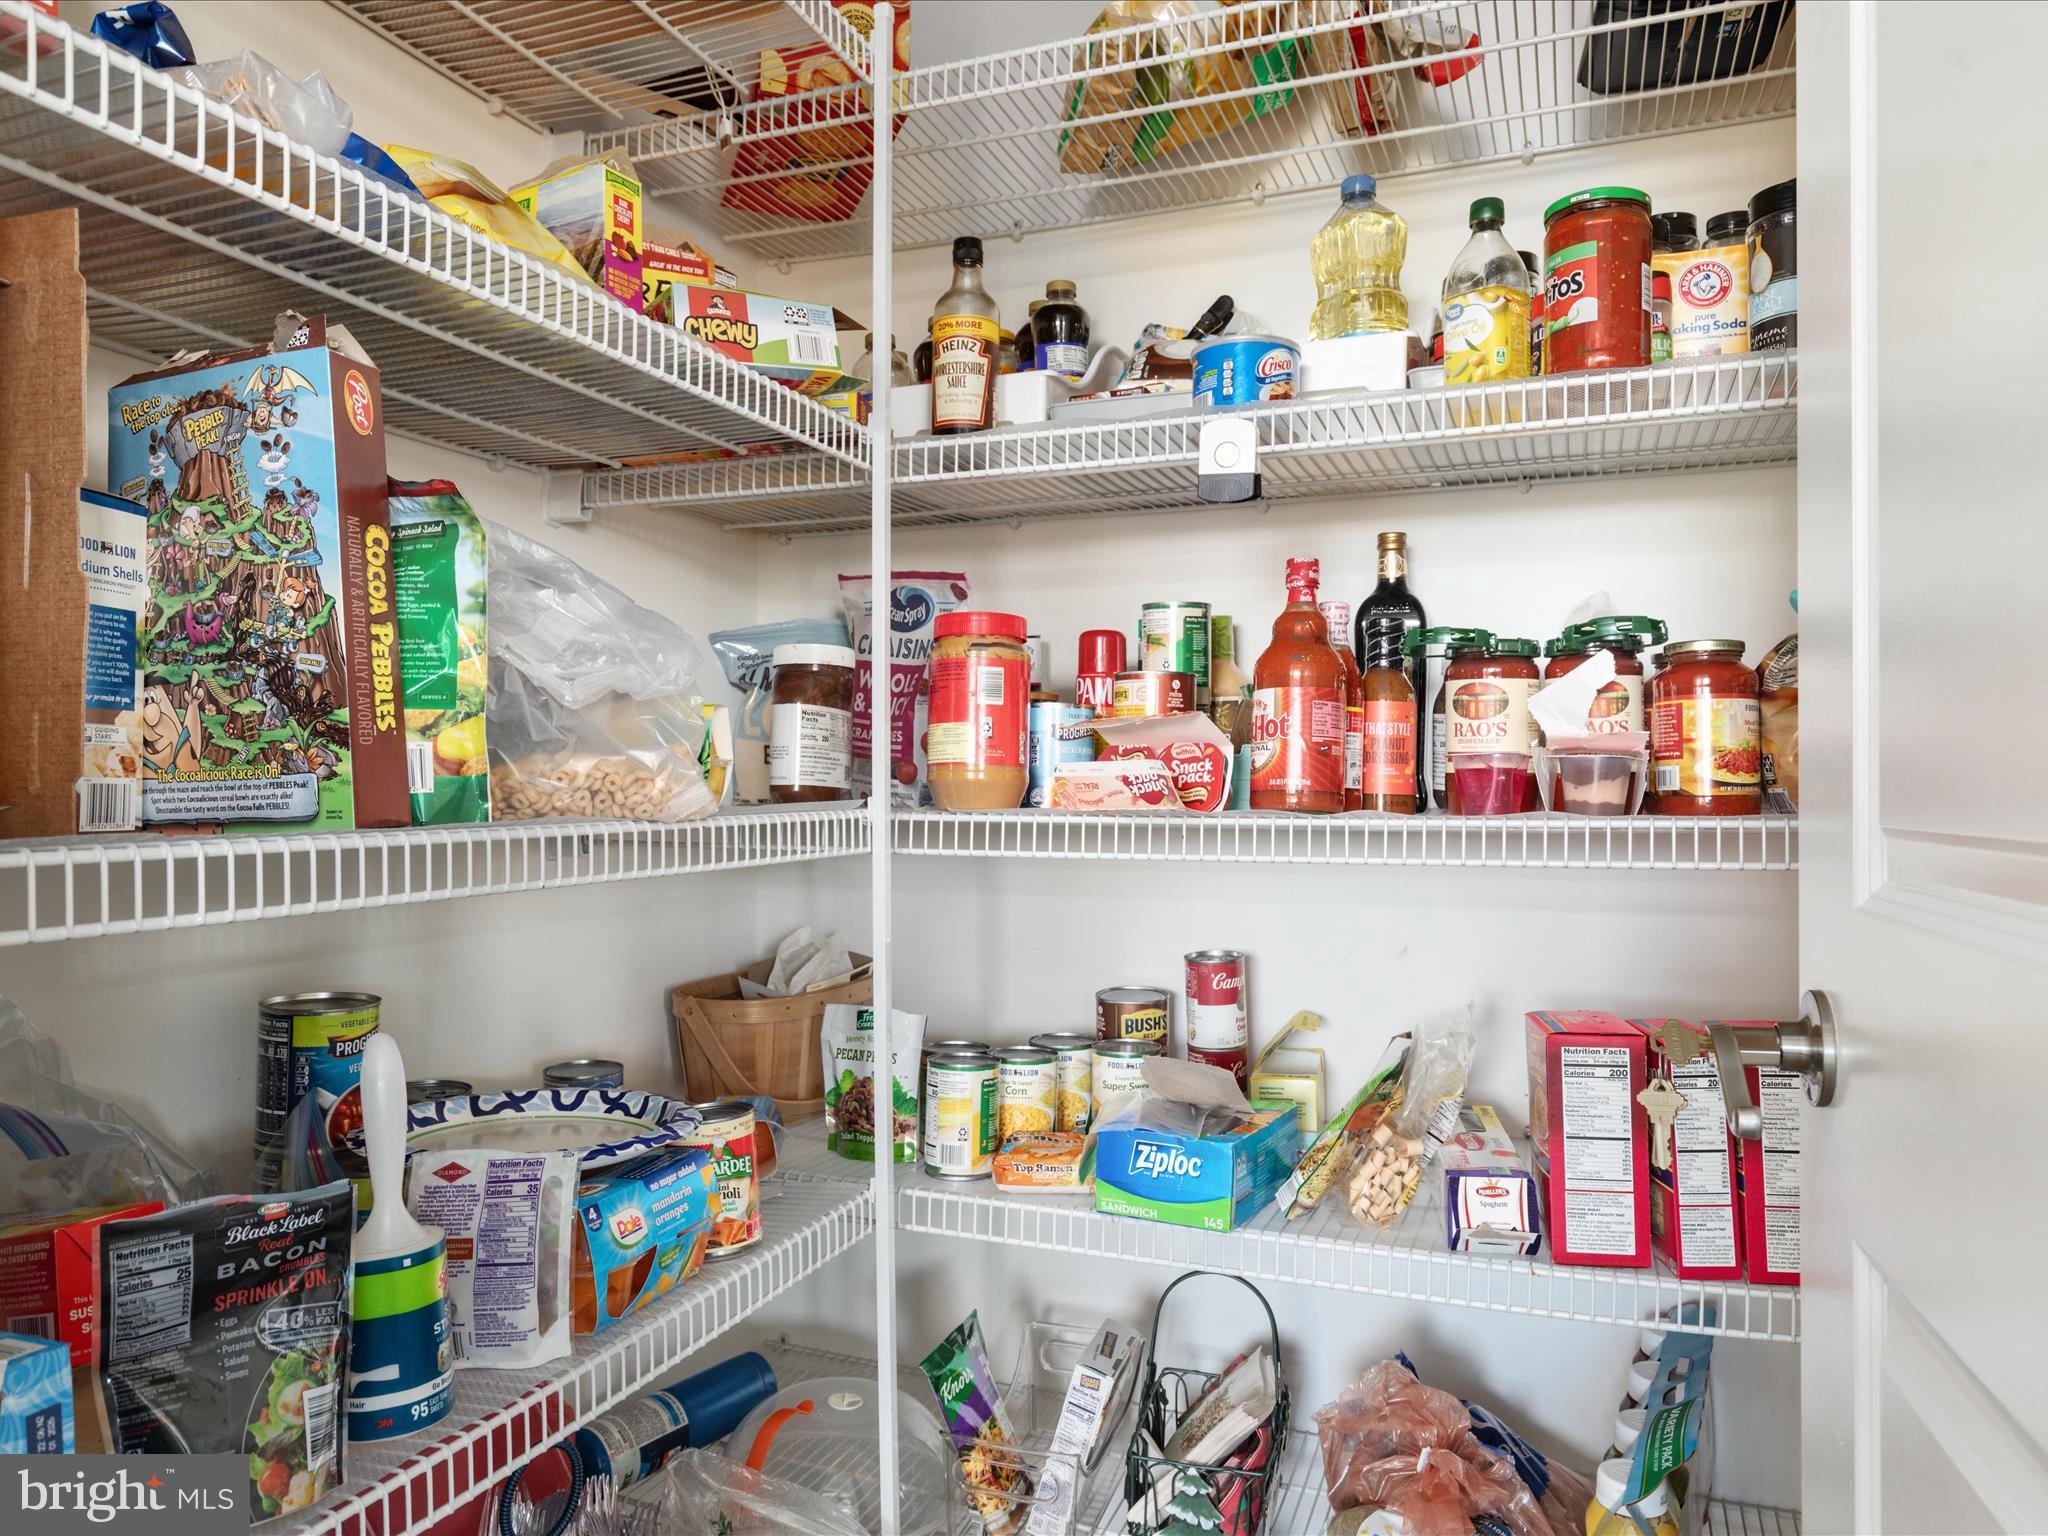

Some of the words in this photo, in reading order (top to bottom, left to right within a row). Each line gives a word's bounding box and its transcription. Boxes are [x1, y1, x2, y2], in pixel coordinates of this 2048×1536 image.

[651, 243, 664, 254] THAI
[665, 247, 680, 257] CHILI
[1682, 270, 1694, 292] ARM
[1699, 263, 1730, 287] HAMMER
[707, 307, 731, 316] QUAKER
[1695, 314, 1716, 324] pure
[938, 322, 954, 331] 20%
[955, 320, 983, 330] MORE
[1673, 322, 1710, 335] aking
[1713, 318, 1747, 330] Soda
[942, 339, 977, 354] HEINZ
[1653, 338, 1672, 350] RLIC
[1261, 356, 1292, 377] Crisco
[947, 375, 968, 389] SAUCE
[347, 373, 369, 429] Post
[121, 401, 150, 426] Race
[151, 396, 161, 411] to
[131, 416, 146, 435] the
[146, 411, 161, 427] top
[183, 411, 225, 441] PEBBLES
[194, 432, 219, 450] PEAK!
[422, 522, 443, 534] Salad
[81, 536, 98, 551] OOD
[115, 544, 136, 560] LION
[347, 515, 363, 586] NATURALLY
[82, 562, 110, 577] dium
[113, 566, 143, 583] Shells
[365, 523, 390, 615] COCOA
[351, 587, 363, 597] &
[904, 602, 926, 627] Spray
[351, 600, 370, 679] ARTIFICIALLY
[369, 621, 397, 732] PEBBLES
[859, 669, 919, 694] WOLE
[1076, 677, 1113, 705] PAM
[1115, 690, 1128, 699] USH'S
[854, 692, 866, 713] &
[355, 682, 373, 745] FLAVORED
[801, 710, 827, 719] Nutrition
[1057, 727, 1094, 741] PROGRES
[1250, 712, 1290, 743] Hot
[1365, 723, 1384, 736] THAI
[1385, 723, 1412, 737] STYLE
[1453, 719, 1508, 738] RAO'S
[1587, 719, 1630, 734] AO'S
[1370, 738, 1407, 750] PEANUT
[1457, 737, 1502, 746] HOMEMADE
[1175, 748, 1196, 757] within
[1365, 751, 1410, 765] DRESSING
[157, 769, 173, 783] The
[174, 767, 228, 781] Cocoalicious
[230, 765, 254, 780] Race
[255, 766, 262, 779] is
[264, 763, 281, 779] On!
[1170, 759, 1213, 778] Snack
[148, 787, 167, 796] through
[200, 785, 214, 793] reach
[223, 783, 236, 791] bowl
[269, 781, 293, 790] PEBBLES
[293, 780, 309, 789] Peak!
[1128, 778, 1169, 798] Snack
[272, 1020, 289, 1029] Facts
[340, 1016, 369, 1028] VEGETABLE
[1124, 1013, 1168, 1035] BUSH'S
[846, 1035, 865, 1044] Honey
[1143, 1031, 1158, 1039] BEST
[277, 1047, 288, 1057] 170
[835, 1047, 865, 1061] PECAN
[1563, 1047, 1600, 1055] Nutrition
[1602, 1048, 1627, 1056] Facts
[1000, 1067, 1013, 1076] OOD
[1023, 1068, 1039, 1077] LION
[1107, 1061, 1125, 1070] FOOD
[1563, 1069, 1596, 1077] Calories
[1609, 1069, 1629, 1077] 200
[1005, 1085, 1028, 1096] Corn
[1102, 1080, 1126, 1092] Super
[489, 1160, 521, 1169] Nutrition
[522, 1159, 544, 1167] Facts
[713, 1155, 752, 1176] ARDEE
[1013, 1163, 1033, 1174] Top
[1035, 1163, 1073, 1173] Ramen
[1135, 1143, 1202, 1179] Ziploc
[438, 1169, 468, 1177] DIAMOND
[650, 1182, 659, 1192] no
[659, 1172, 677, 1187] sugar
[677, 1162, 697, 1178] added
[486, 1188, 513, 1197] Calories
[526, 1184, 539, 1194] 35
[719, 1184, 730, 1192] ini
[651, 1185, 692, 1213] mandarin
[1479, 1200, 1509, 1210] Spaghetti
[264, 1201, 289, 1214] Hormel
[588, 1207, 597, 1220] 4
[655, 1202, 689, 1226] oranges
[1099, 1200, 1158, 1220] SANDWICH
[225, 1223, 278, 1246] Black
[279, 1208, 325, 1232] Label
[616, 1214, 641, 1236] Dole
[1203, 1216, 1224, 1230] 145
[259, 1234, 294, 1252] Real
[115, 1246, 161, 1262] Nutrition
[162, 1240, 191, 1253] Facts
[216, 1236, 327, 1280] BACON
[279, 1252, 327, 1274] CRUMBLES
[116, 1279, 154, 1294] Calories
[176, 1268, 192, 1281] 25
[213, 1275, 300, 1313] SPRINKLE
[220, 1316, 239, 1329] Eggs
[221, 1326, 257, 1341] Pancakes
[222, 1339, 256, 1355] Potatoes
[224, 1354, 250, 1368] Salads
[225, 1368, 249, 1381] Soups
[939, 1366, 974, 1406] Knorr
[350, 1401, 366, 1409] Hair
[411, 1401, 429, 1421] 95
[376, 1418, 394, 1429] 3M
[1086, 1414, 1095, 1422] 30
[1661, 1406, 1682, 1445] VARIETY
[1661, 1445, 1673, 1470] PACK
